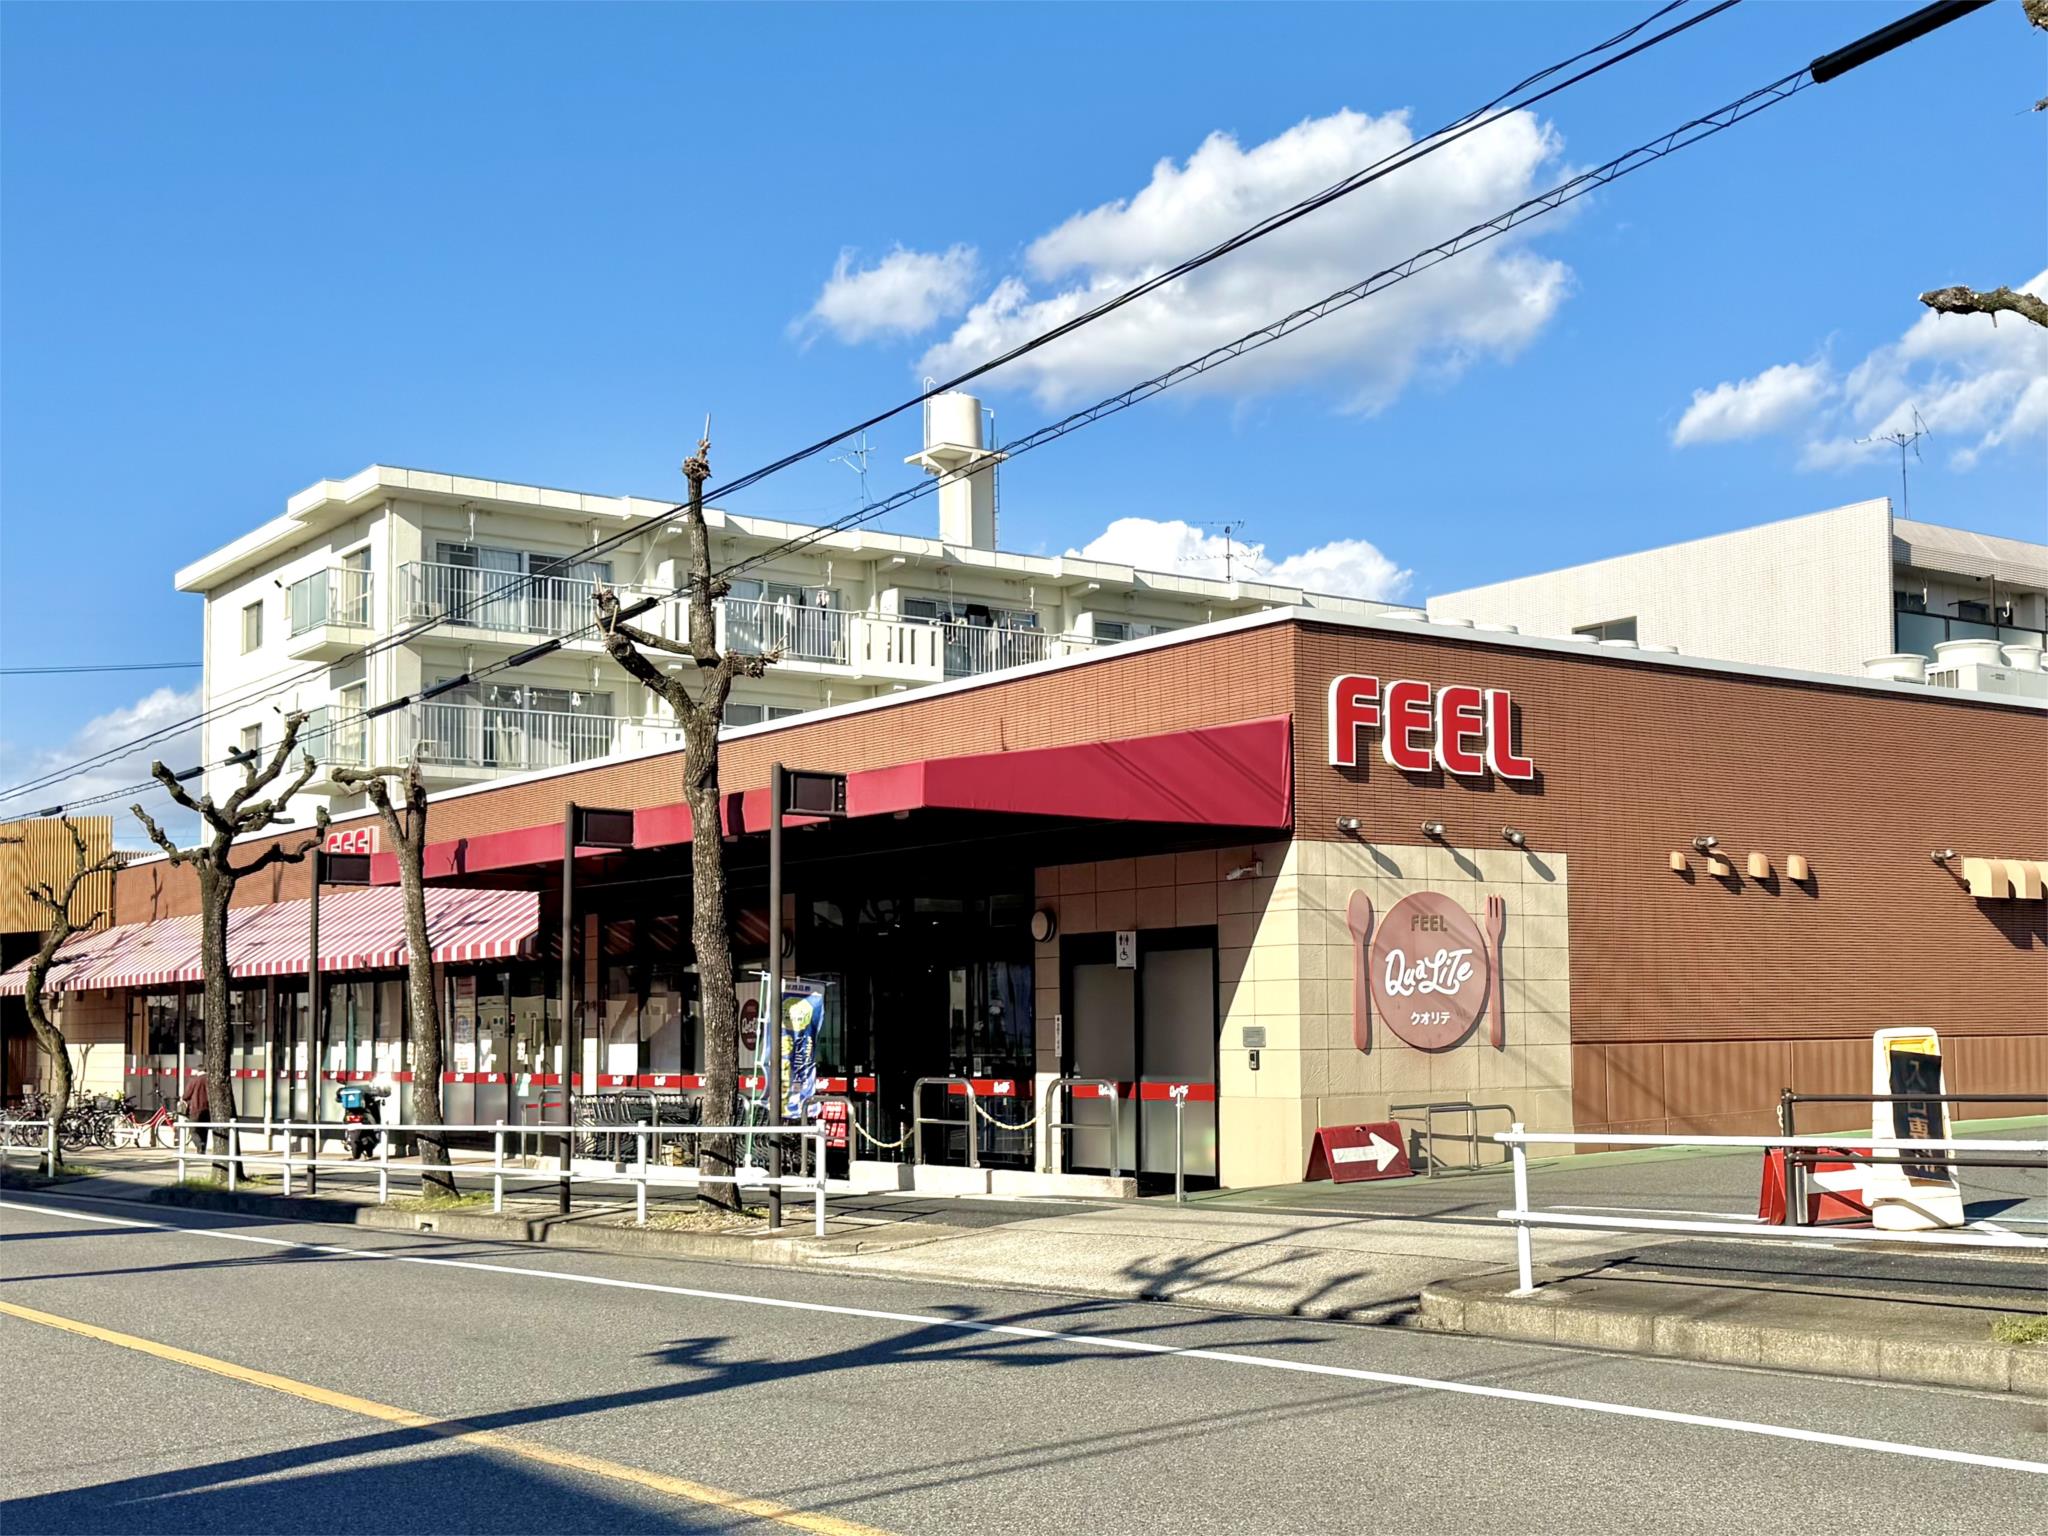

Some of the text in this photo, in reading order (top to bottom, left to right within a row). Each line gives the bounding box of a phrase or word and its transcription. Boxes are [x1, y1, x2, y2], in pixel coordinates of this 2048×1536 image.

[1328, 673, 1534, 780] FEEL
[1411, 914, 1449, 932] FEEL
[1410, 1011, 1451, 1025] クオリテ
